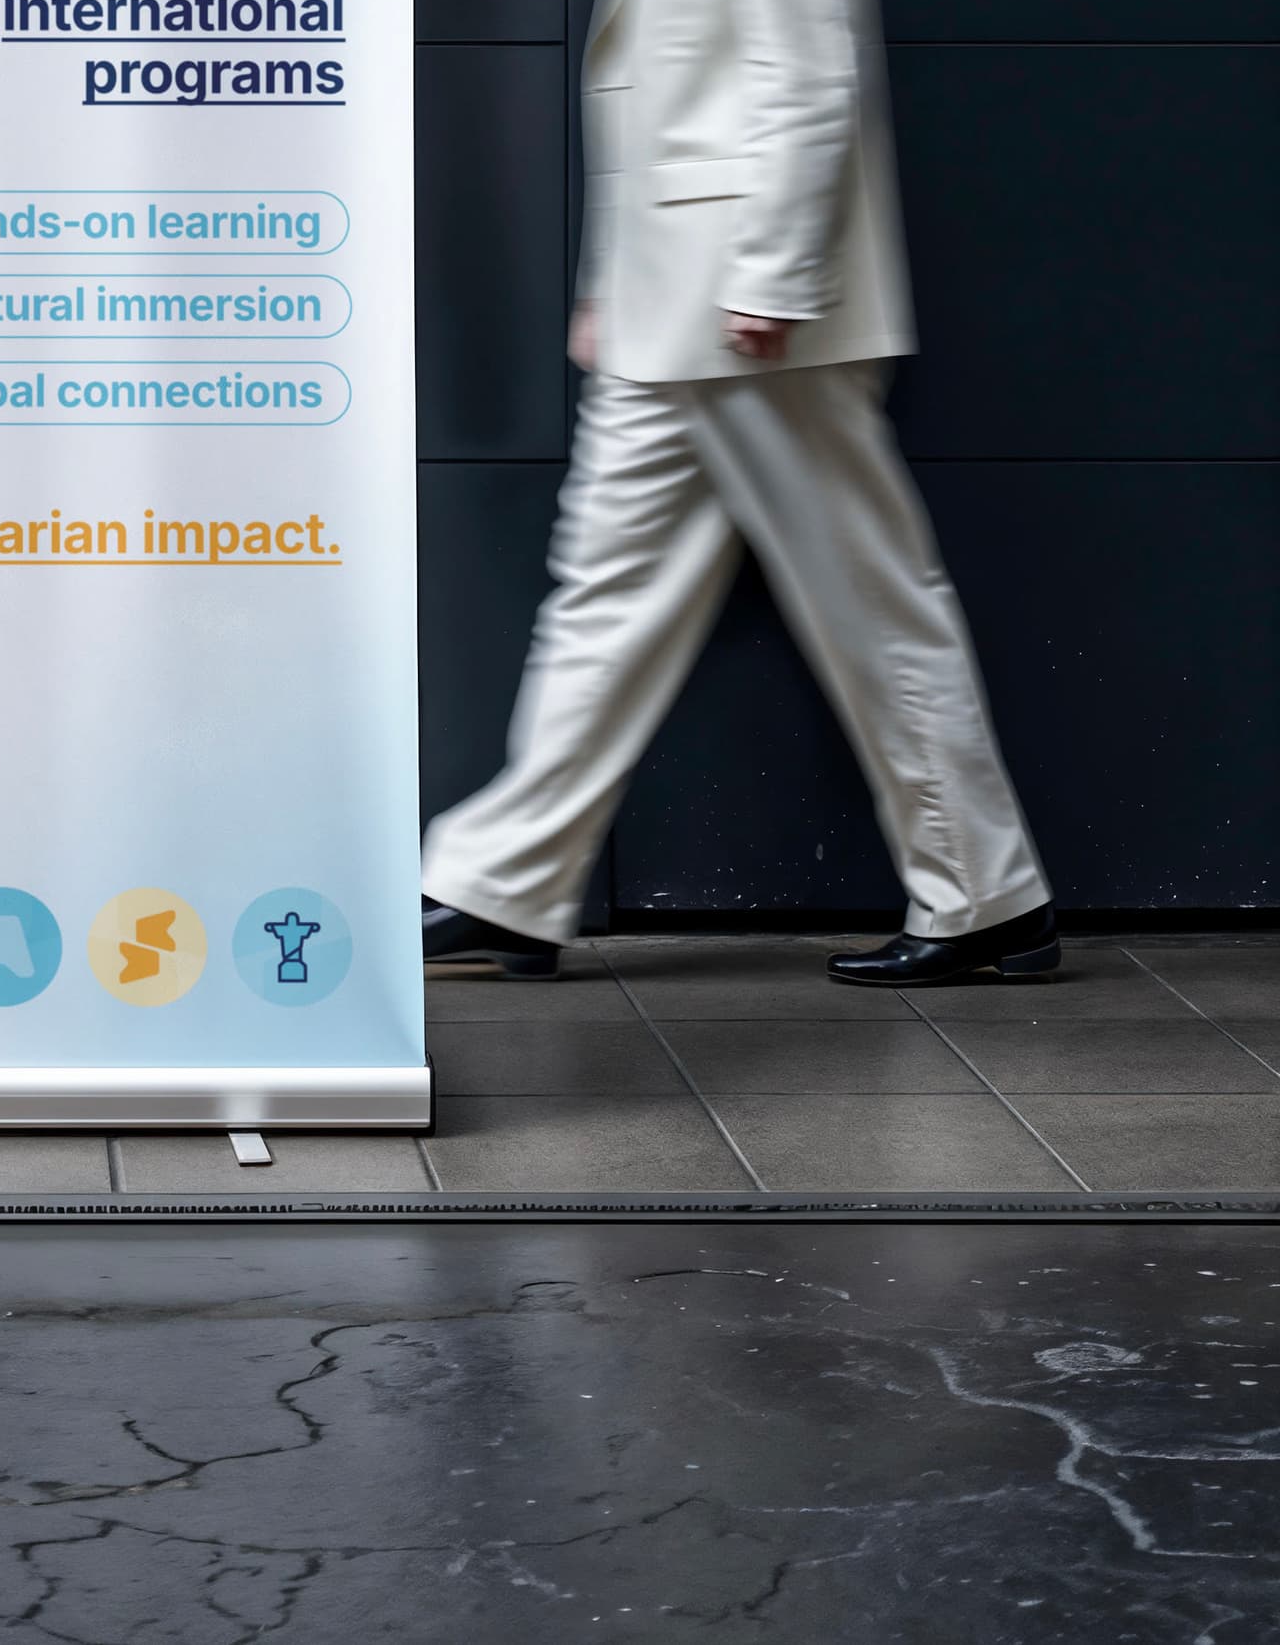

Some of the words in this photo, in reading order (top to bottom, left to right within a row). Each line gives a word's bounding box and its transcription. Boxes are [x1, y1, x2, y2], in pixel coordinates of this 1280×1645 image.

[82, 56, 345, 106] programs
[148, 202, 320, 249] learning
[97, 285, 321, 322] immersion
[57, 371, 323, 409] connections
[143, 509, 342, 565] impact.
